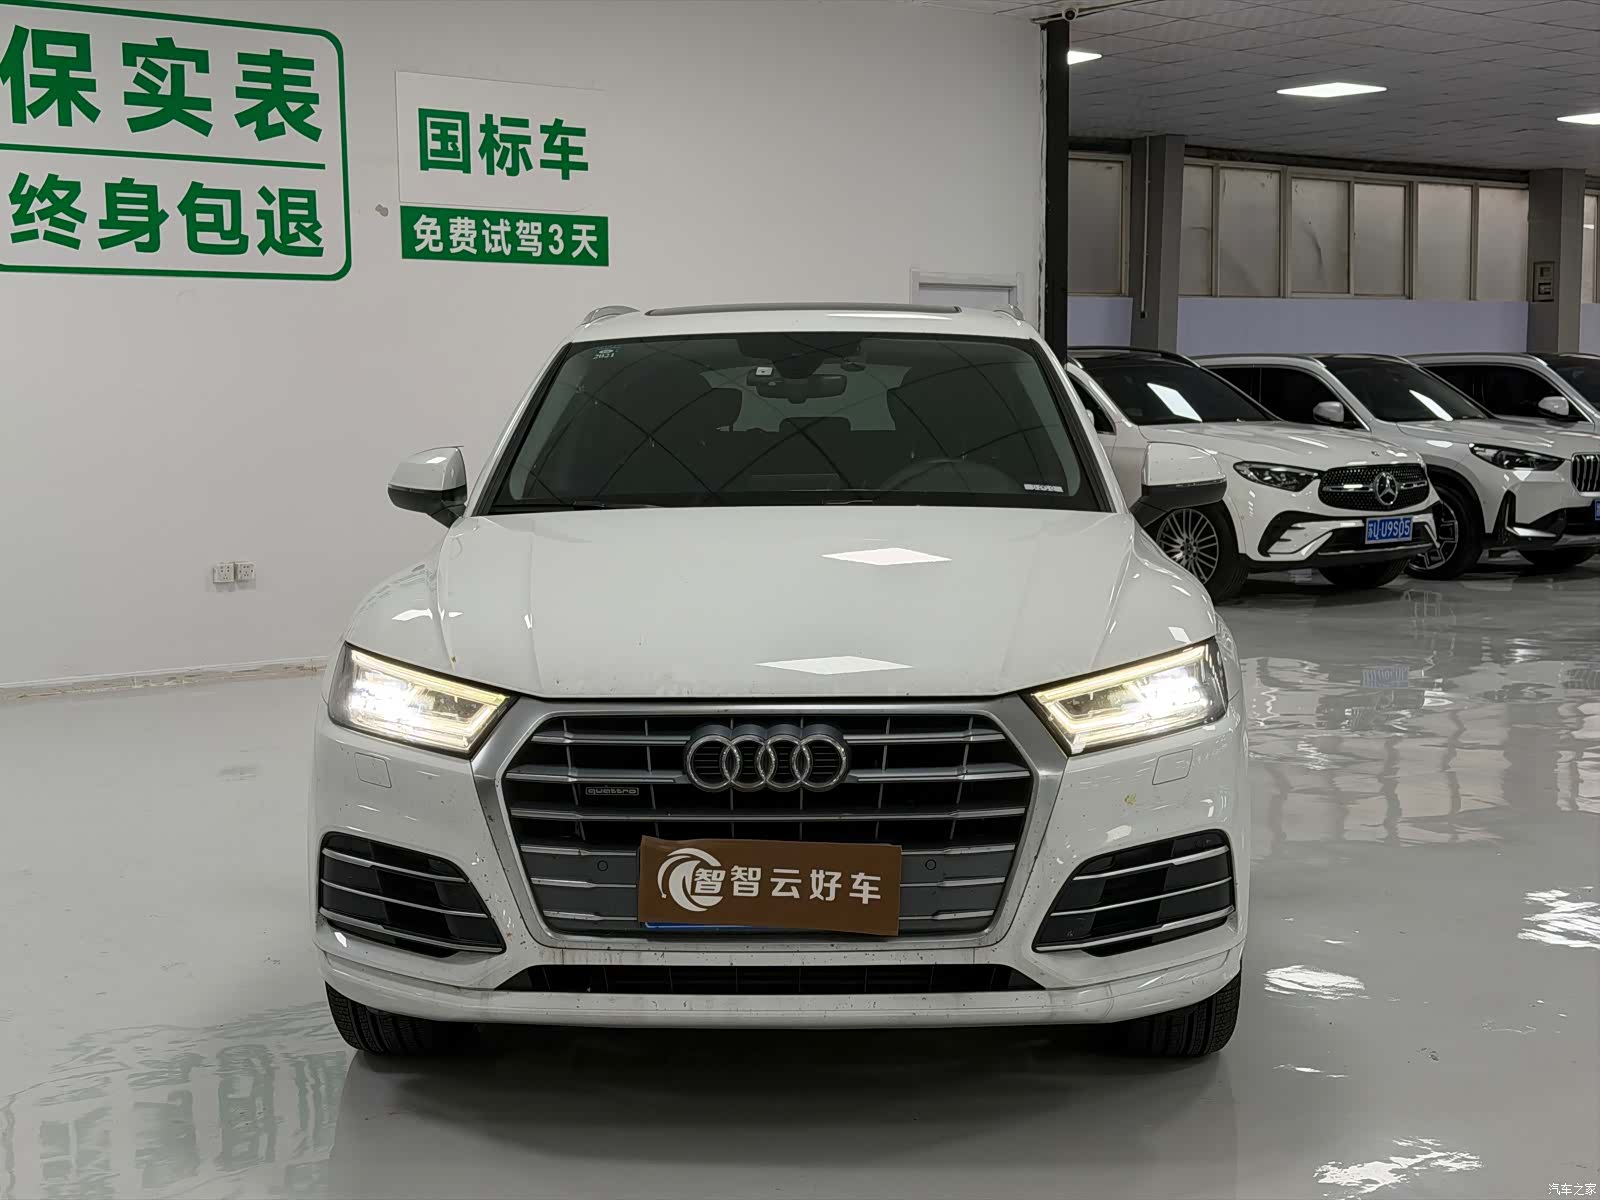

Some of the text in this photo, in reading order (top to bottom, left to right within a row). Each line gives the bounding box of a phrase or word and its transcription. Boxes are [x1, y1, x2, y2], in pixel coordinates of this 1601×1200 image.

[0, 25, 322, 142] 保实表
[418, 108, 589, 181] 国标车
[9, 172, 325, 257] 终身包退
[413, 214, 599, 259] 免费试驾3天
[693, 865, 881, 905] 智智云好车
